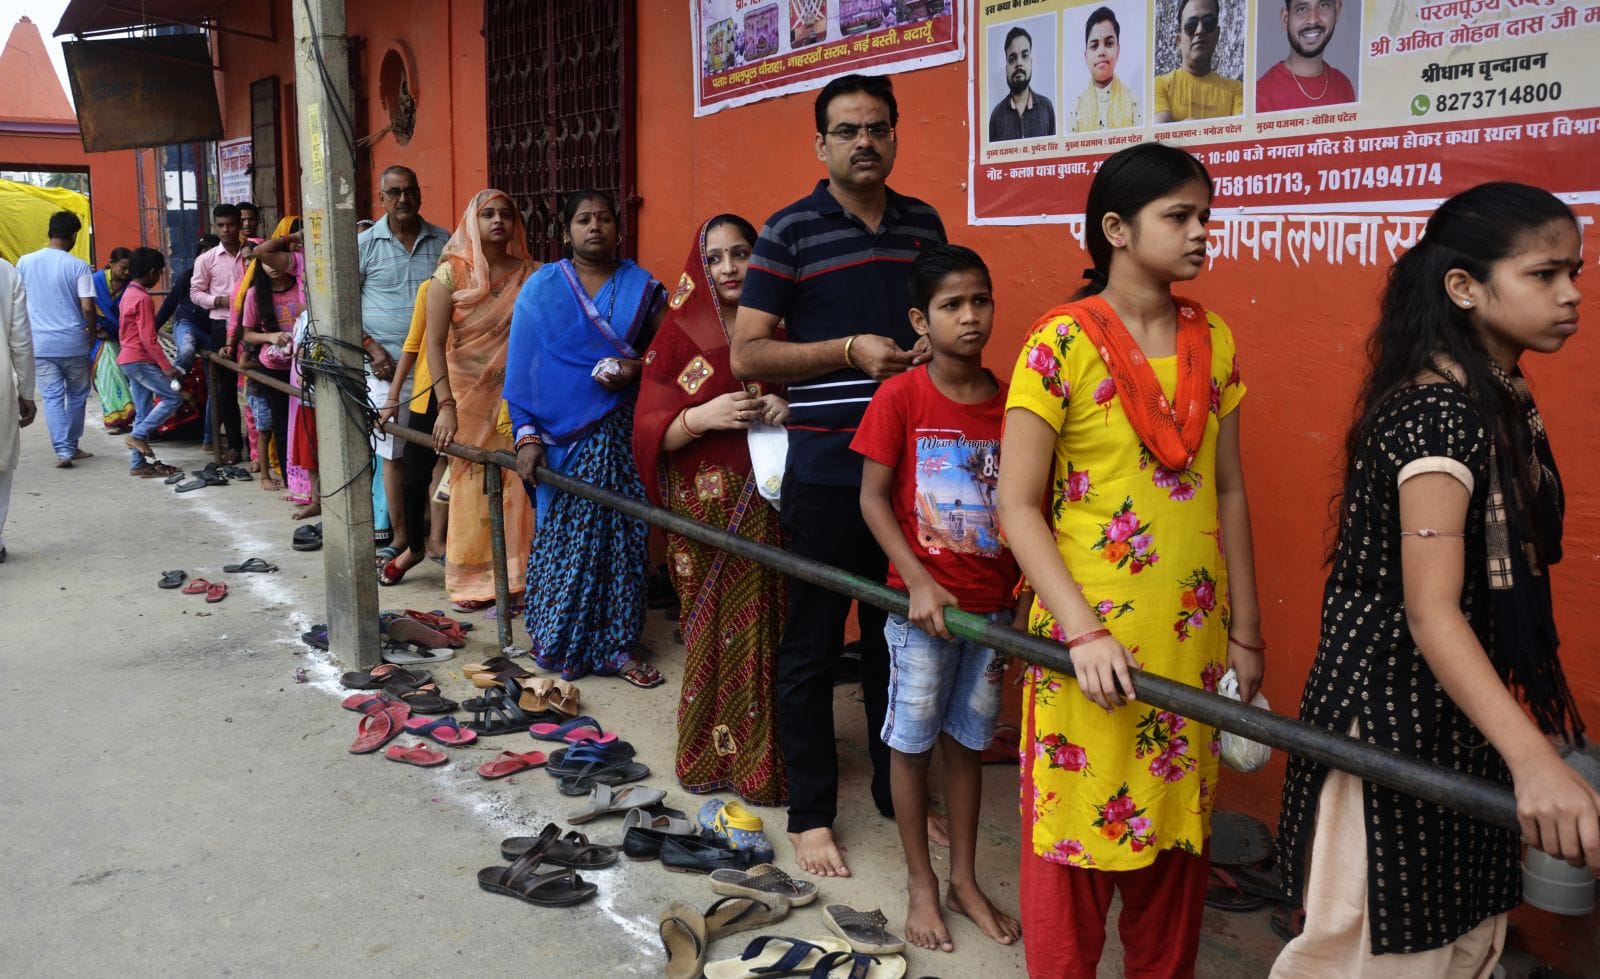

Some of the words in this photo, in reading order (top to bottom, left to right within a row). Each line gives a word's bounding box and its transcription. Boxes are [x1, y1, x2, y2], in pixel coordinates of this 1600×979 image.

[823, 43, 851, 60] सराय,
[853, 34, 869, 53] नई
[1371, 35, 1391, 57] श्री
[1396, 30, 1444, 52] अमित
[1450, 23, 1500, 45] मोहन
[1506, 16, 1544, 36] दास
[1551, 6, 1578, 30] जी
[1584, 7, 1600, 23] म
[1421, 62, 1475, 83] श्रीधाम
[1479, 52, 1548, 81] वृन्दावन
[1436, 81, 1562, 113] 8273714800
[1203, 125, 1224, 136] मनोज
[1225, 123, 1242, 134] पटेल
[1256, 122, 1274, 133] मुख्य
[1276, 118, 1305, 129] यजमान
[1312, 113, 1335, 124] मोहित
[1337, 111, 1357, 122] पटेल
[1009, 167, 1034, 179] कलश
[1036, 164, 1056, 177] यात्रा
[1208, 149, 1240, 165] 10:00
[1243, 143, 1264, 161] बजे
[1267, 143, 1305, 159] नगला
[1307, 138, 1341, 156] मंदिर
[1342, 136, 1355, 153] से
[1359, 134, 1399, 153] प्रारम्भ
[1402, 130, 1443, 149] होकर
[1446, 128, 1481, 145] कथा
[1526, 121, 1550, 138] पर
[1552, 116, 1600, 137] विश्रा
[1212, 171, 1311, 197] 758161713,
[1318, 162, 1443, 192] 7017494774
[1206, 214, 1285, 272] ज्ञापन
[1287, 214, 1384, 268] लगाना
[919, 434, 954, 450] Wave
